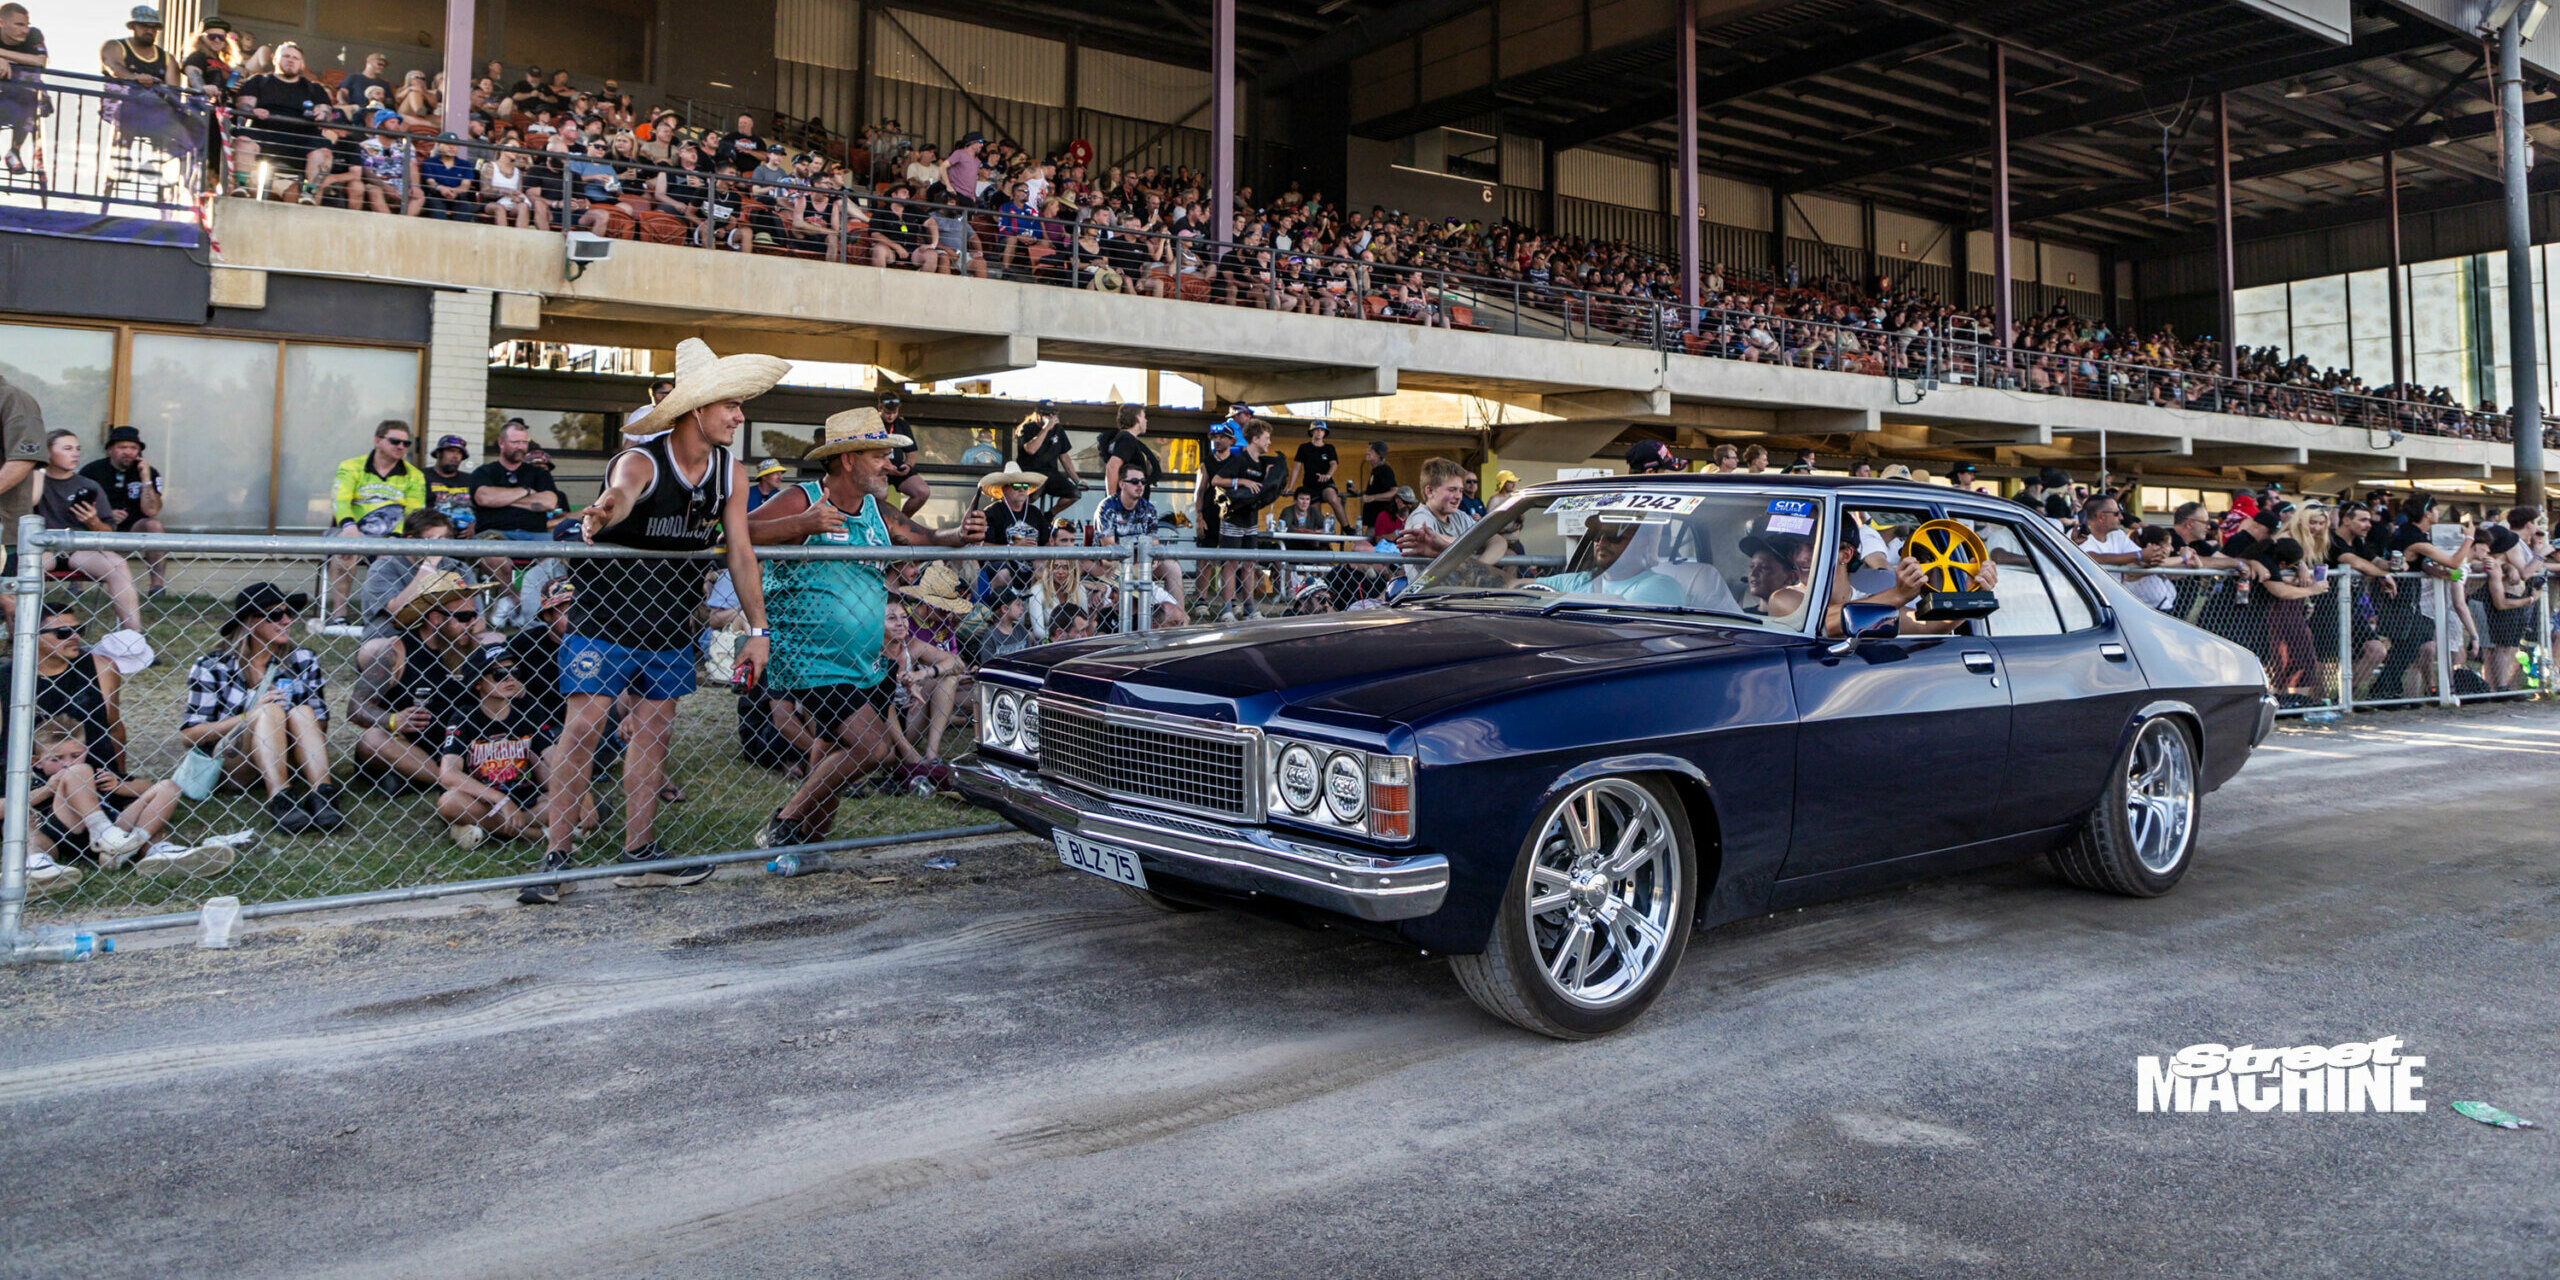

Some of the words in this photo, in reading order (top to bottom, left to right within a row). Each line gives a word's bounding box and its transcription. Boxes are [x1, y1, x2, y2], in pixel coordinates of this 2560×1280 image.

[1483, 189, 1492, 203] C
[1625, 494, 1683, 510] 1242
[1774, 500, 1806, 511] CITY
